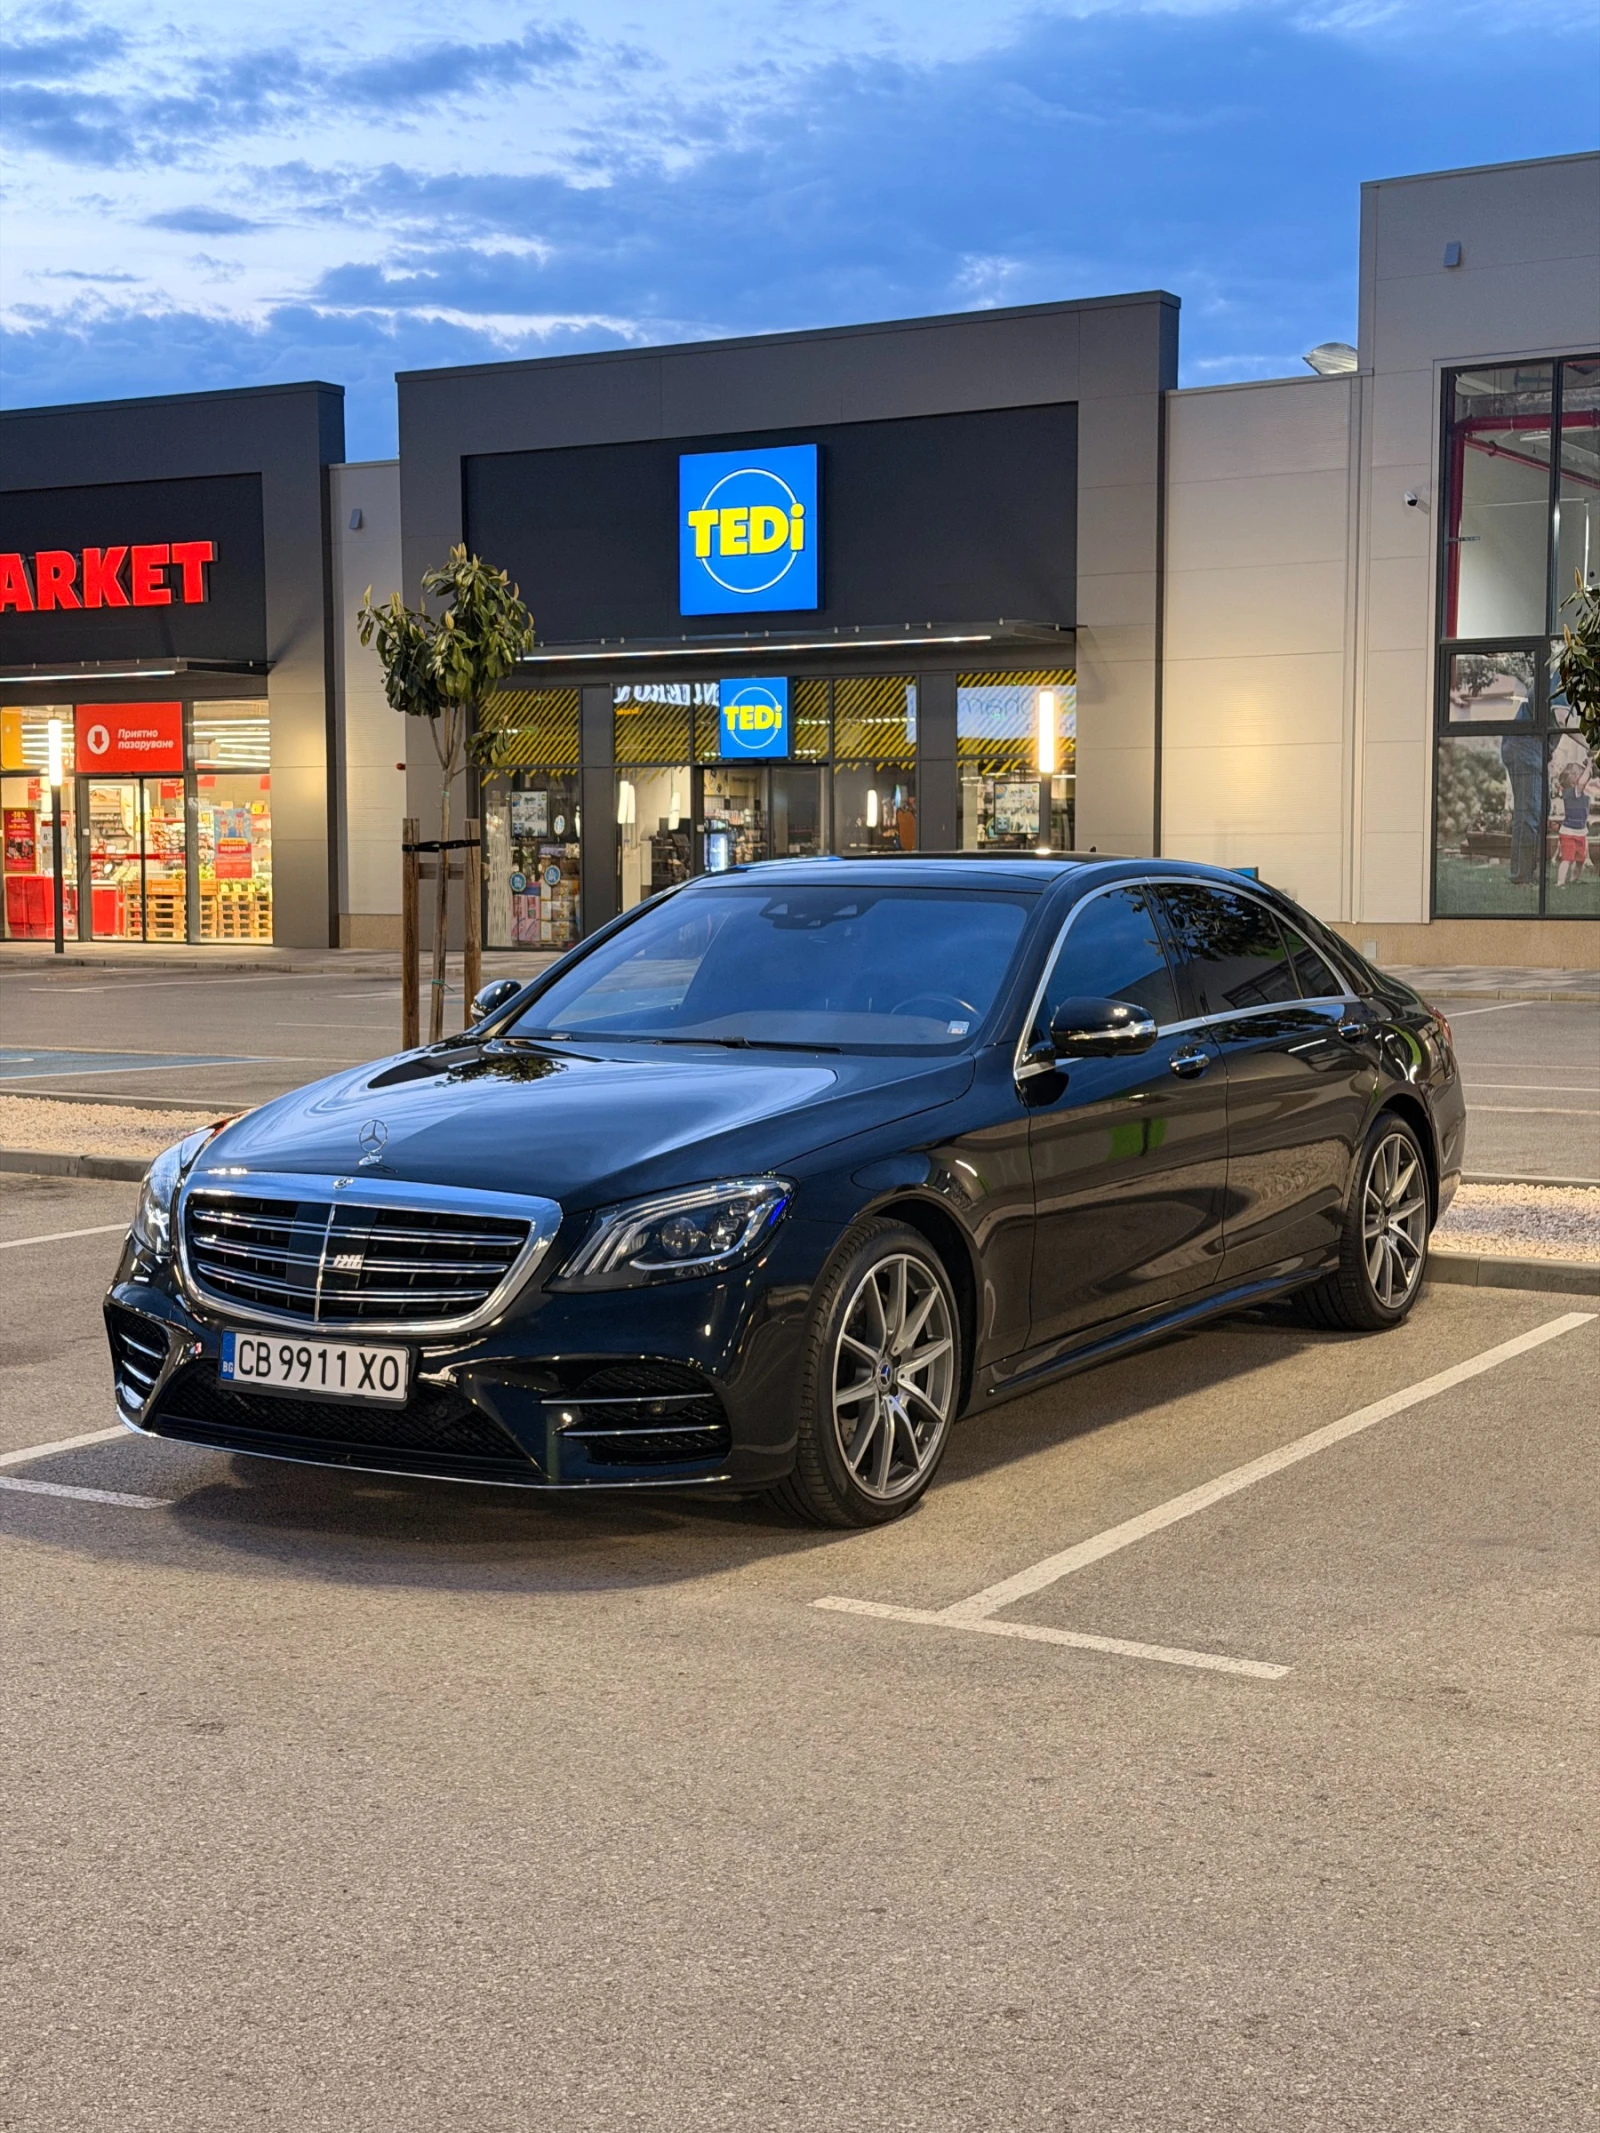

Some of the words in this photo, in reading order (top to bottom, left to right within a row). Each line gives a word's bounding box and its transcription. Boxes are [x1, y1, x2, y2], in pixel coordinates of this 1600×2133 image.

[688, 503, 805, 558] TEDi
[0, 541, 213, 612] ARKET
[723, 704, 782, 731] TEDi
[118, 729, 158, 740] Приятно
[118, 739, 174, 751] пазаруване
[222, 1361, 234, 1373] BG
[239, 1340, 271, 1377] CB
[279, 1345, 347, 1387] 9911
[357, 1353, 399, 1391] XO
